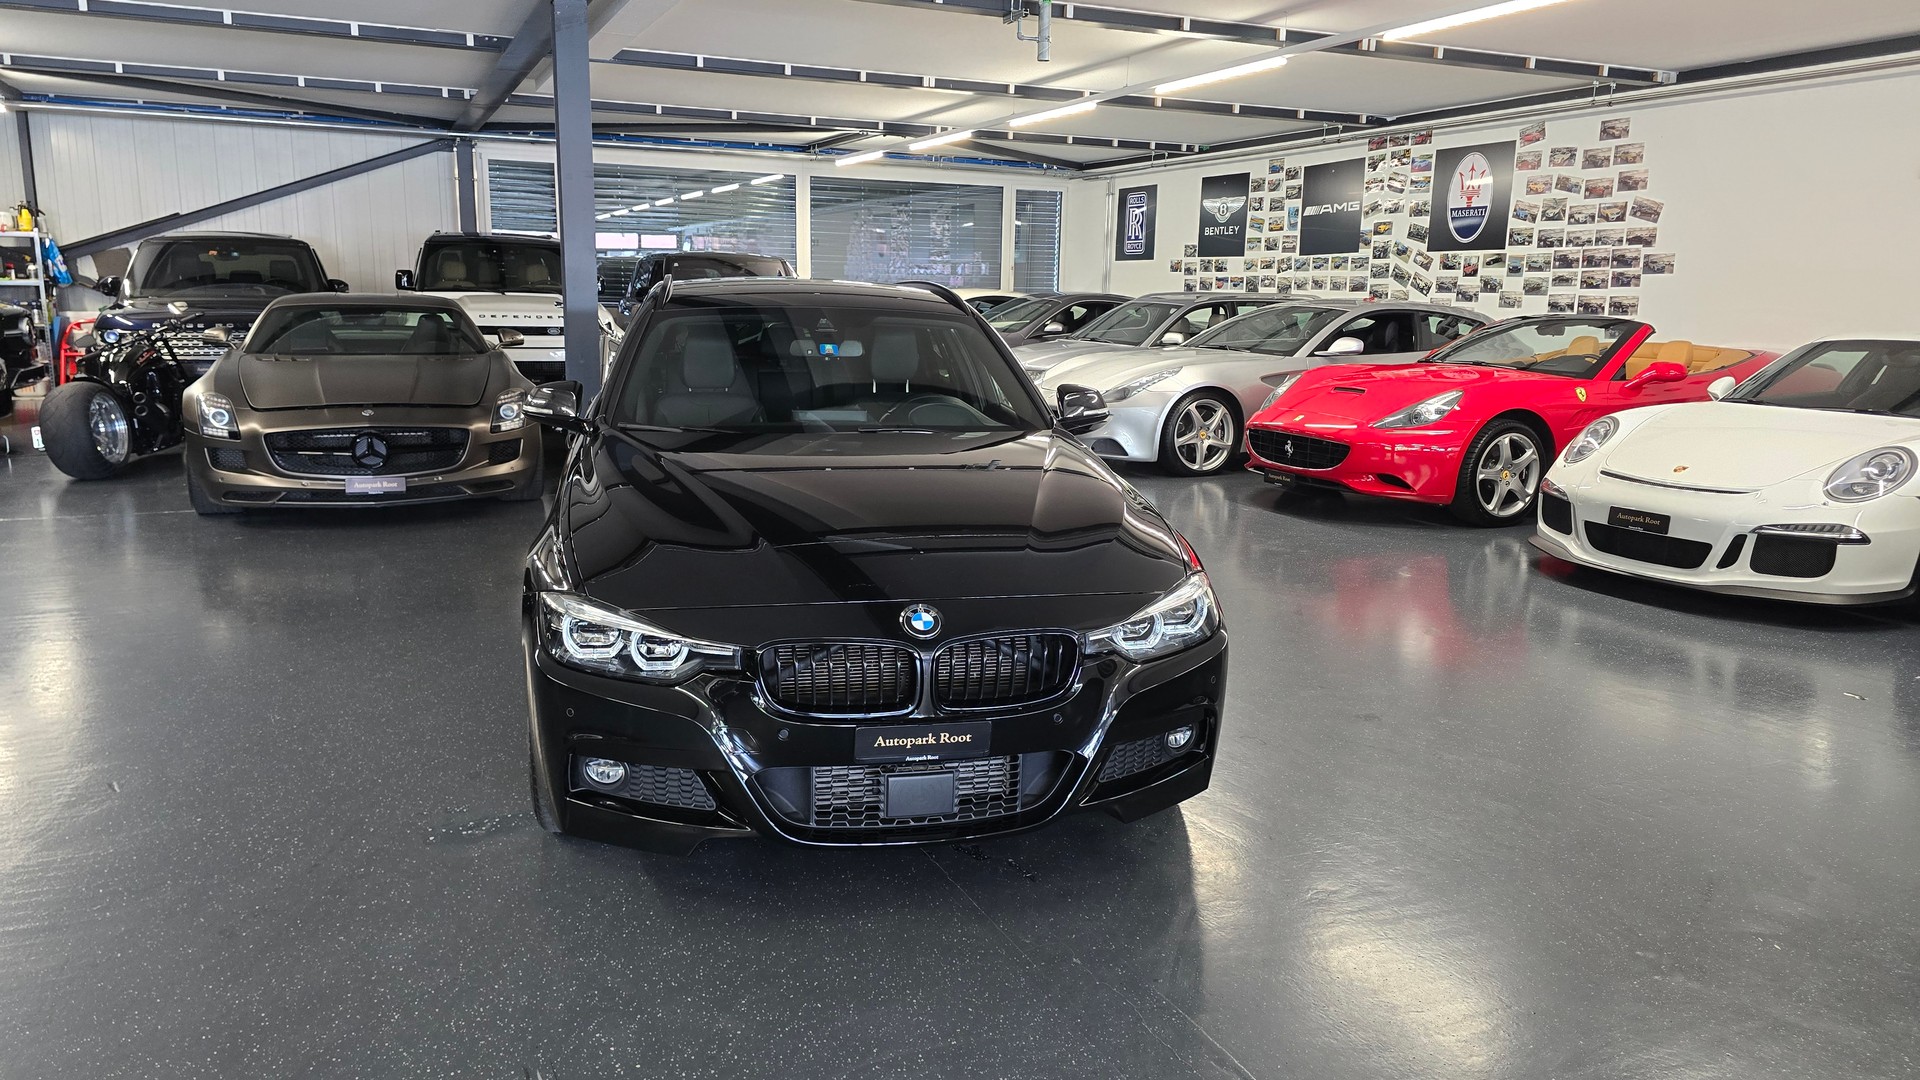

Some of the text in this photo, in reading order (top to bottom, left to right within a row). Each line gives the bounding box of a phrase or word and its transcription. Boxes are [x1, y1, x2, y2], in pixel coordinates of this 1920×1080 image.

[1129, 196, 1145, 204] ROLLS
[1319, 201, 1361, 215] AMG
[1451, 209, 1486, 218] MASERATI
[1204, 226, 1240, 236] BENTLEY
[1126, 242, 1142, 250] ROYCE
[1616, 512, 1661, 526] Autopark Root
[874, 732, 972, 749] Autopark Root
